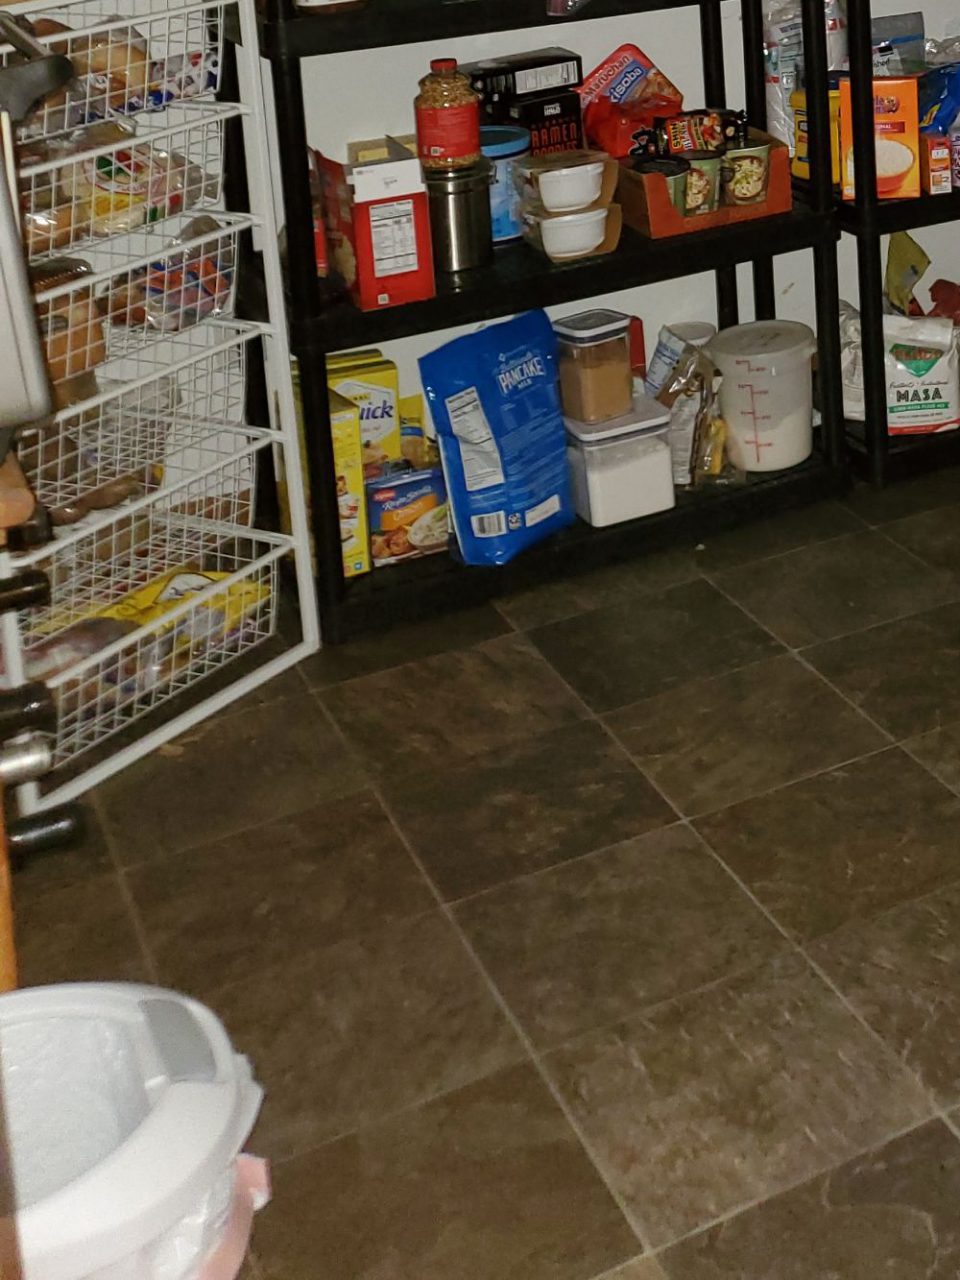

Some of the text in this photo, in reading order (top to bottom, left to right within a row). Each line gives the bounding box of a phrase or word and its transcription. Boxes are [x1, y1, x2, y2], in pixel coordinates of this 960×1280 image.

[586, 55, 632, 99] Maruchan
[530, 122, 578, 146] RAMEN
[498, 356, 546, 394] PANCAKE
[896, 387, 943, 403] MASA
